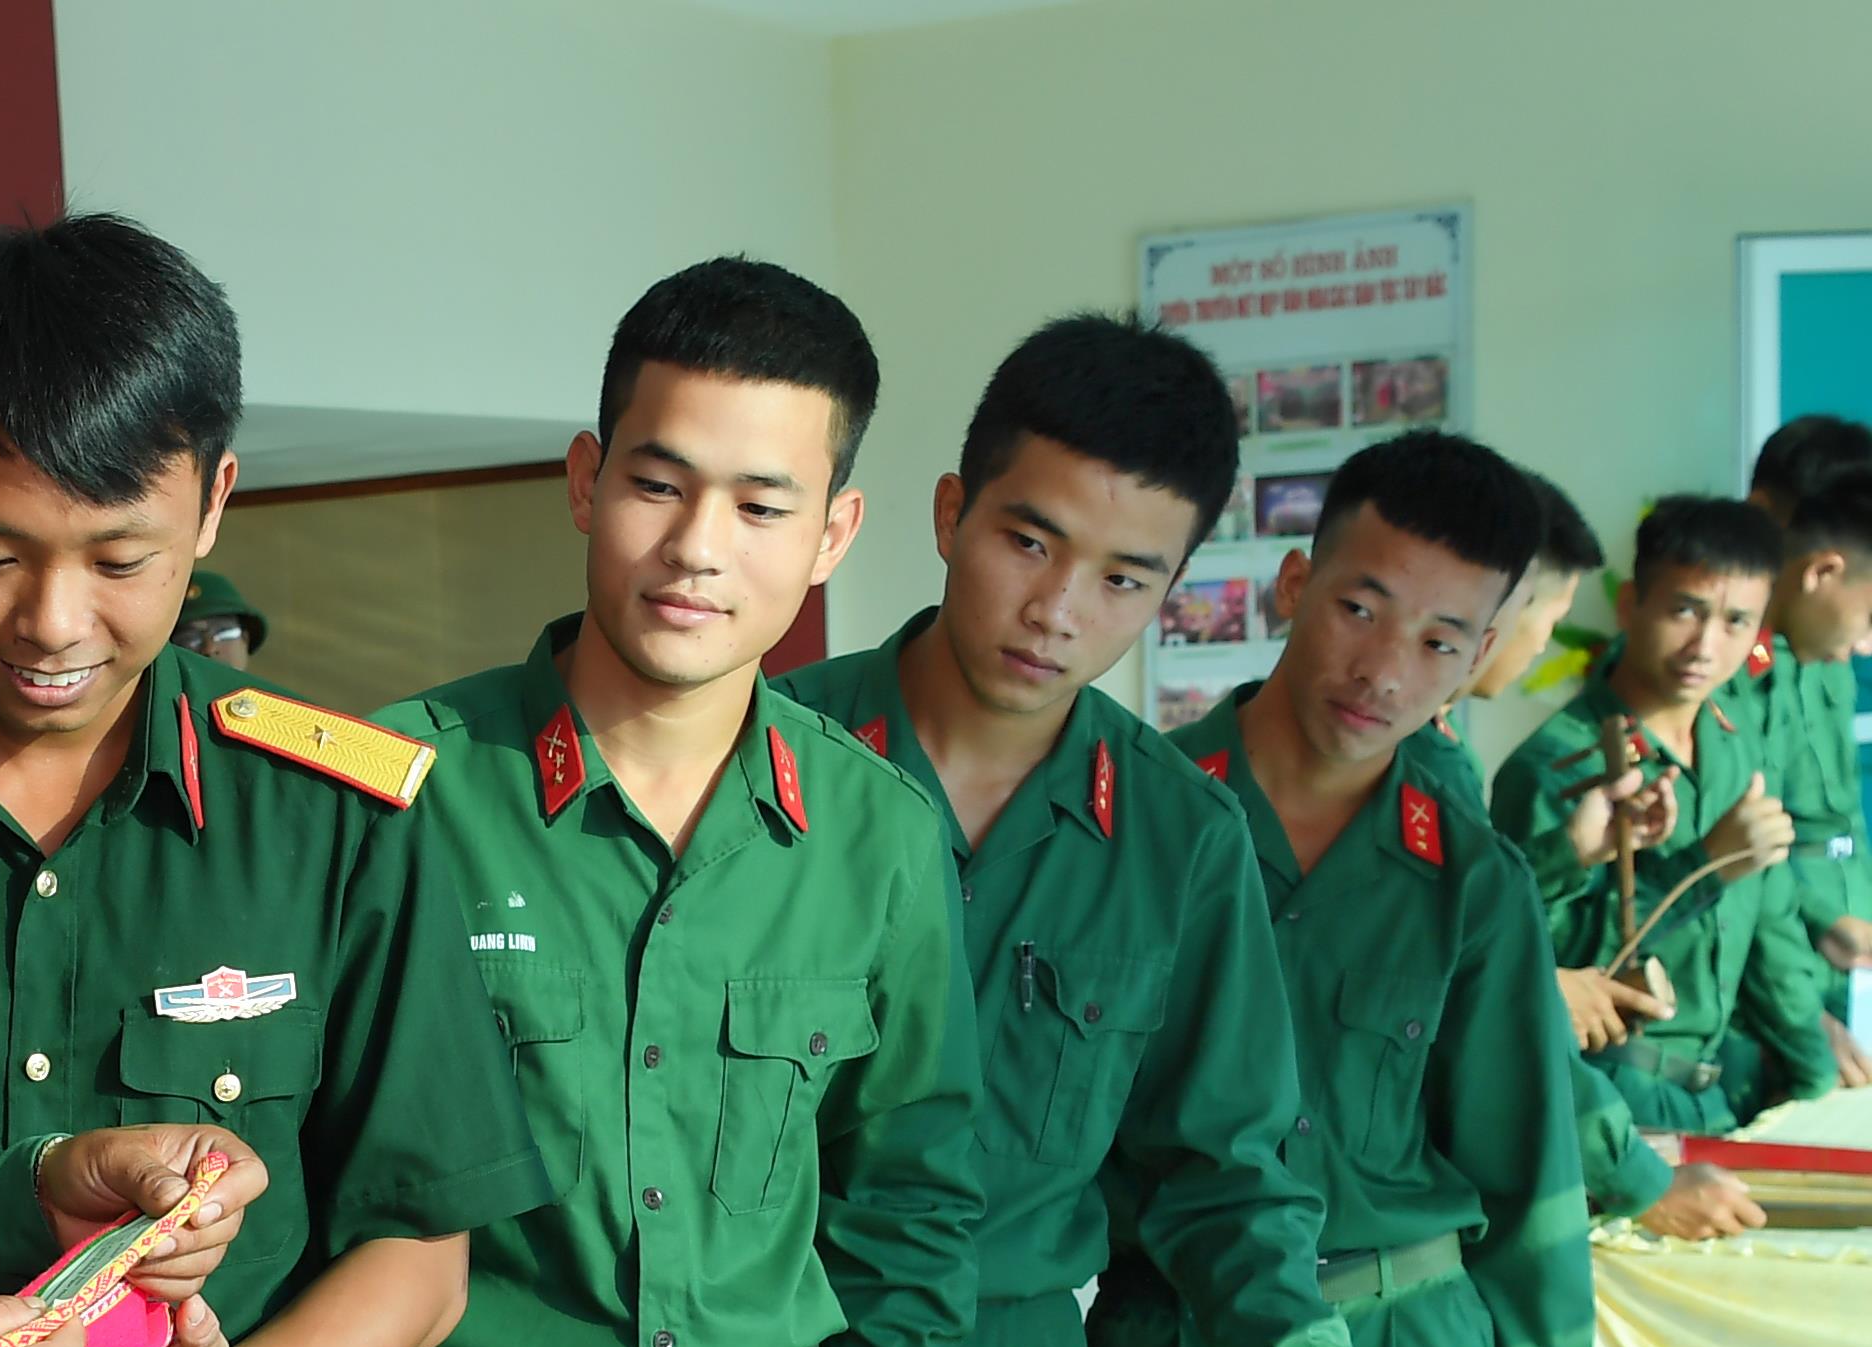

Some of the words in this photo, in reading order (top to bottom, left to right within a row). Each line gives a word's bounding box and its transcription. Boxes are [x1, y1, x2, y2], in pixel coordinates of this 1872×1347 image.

[1211, 255, 1253, 286] MỘT
[1260, 246, 1287, 280] SỐ
[1292, 247, 1347, 278] HÌNH
[1353, 238, 1399, 271] ẢNH
[470, 932, 505, 951] UANG
